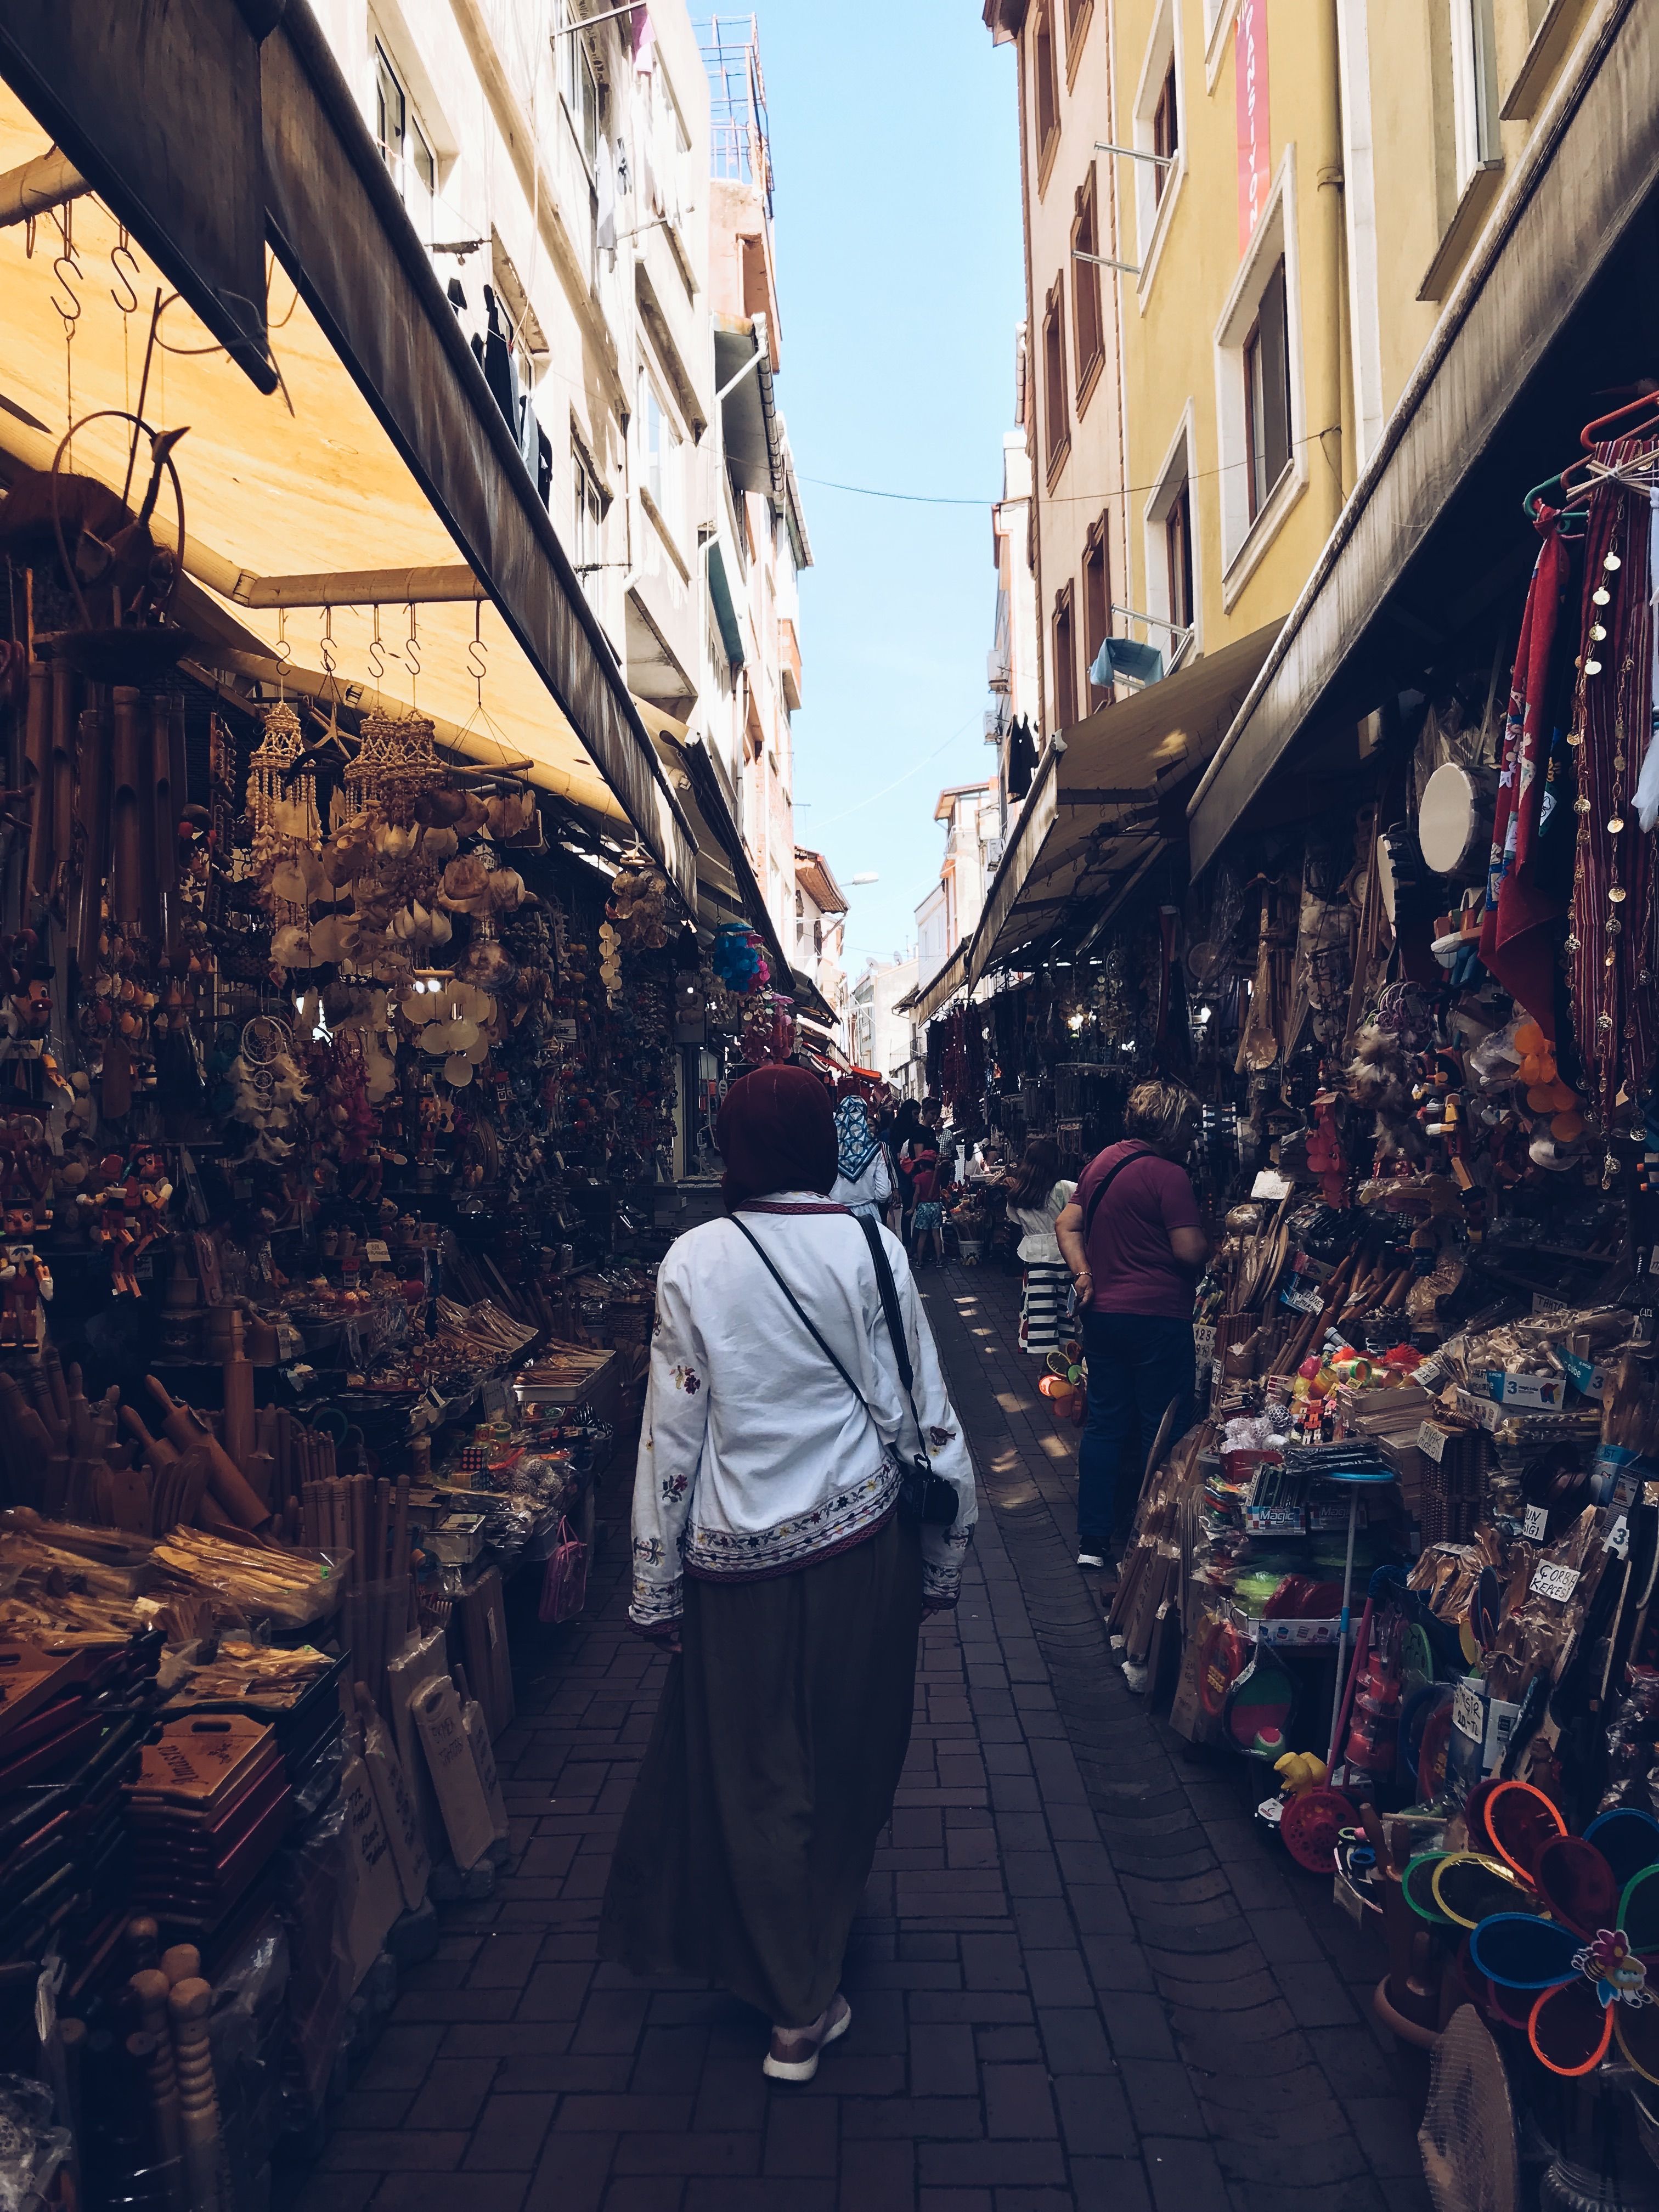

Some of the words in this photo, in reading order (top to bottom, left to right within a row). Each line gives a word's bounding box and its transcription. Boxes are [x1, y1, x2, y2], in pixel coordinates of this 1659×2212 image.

[1507, 1381, 1517, 1395] 3
[1592, 1376, 1604, 1389] 3
[1424, 1426, 1443, 1449] AYAK
[1260, 1509, 1295, 1524] Magic
[1613, 1528, 1627, 1545] 3
[1539, 1565, 1578, 1588] ÇORBA
[1530, 1578, 1571, 1598] KEPÇESİ
